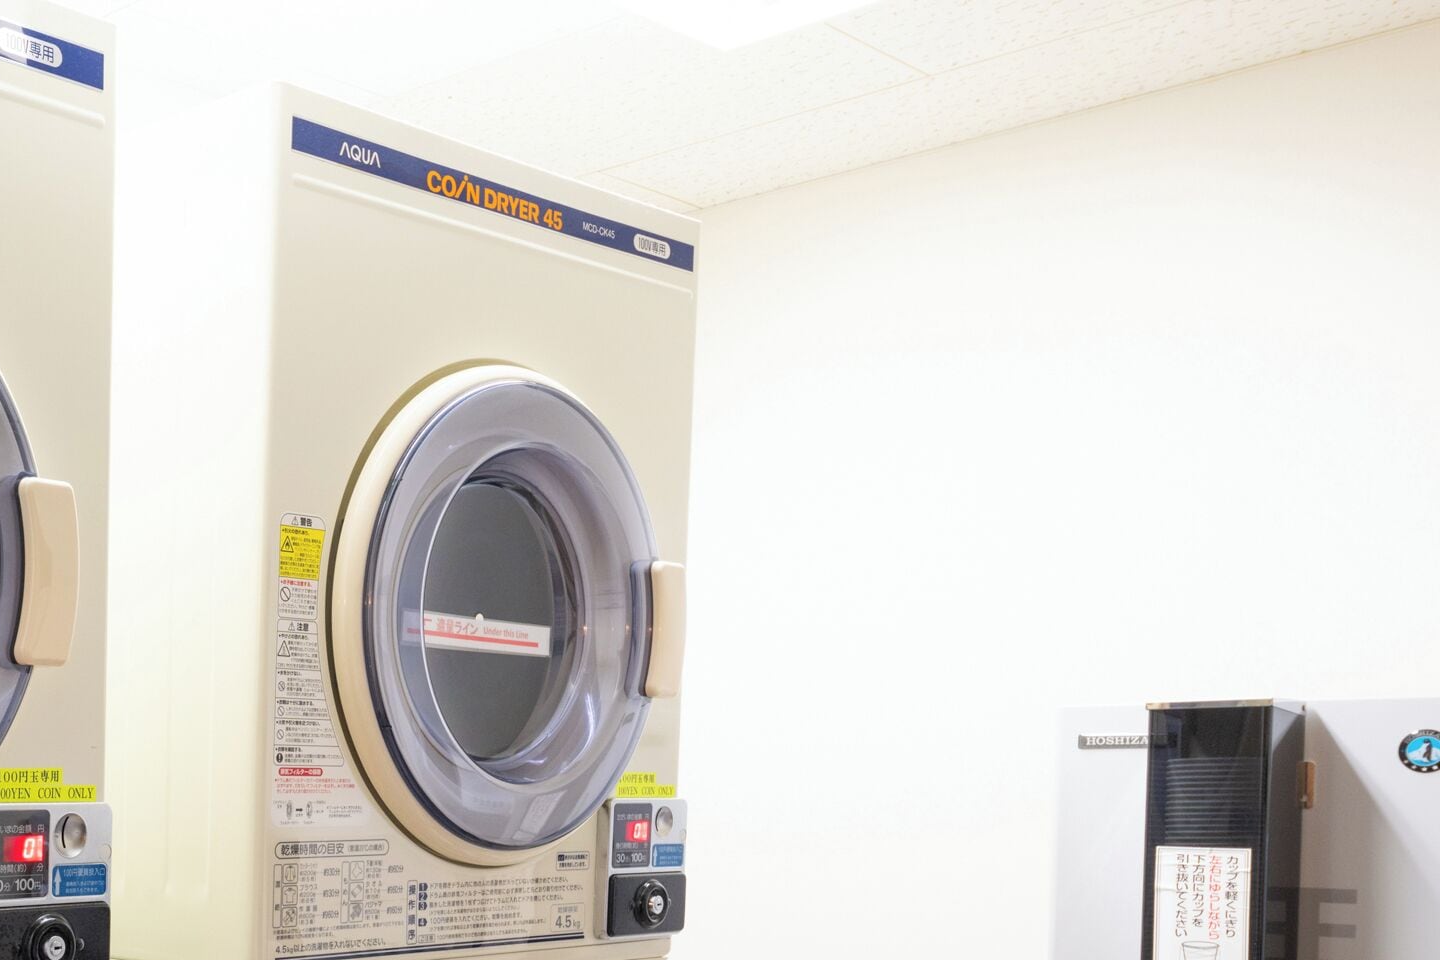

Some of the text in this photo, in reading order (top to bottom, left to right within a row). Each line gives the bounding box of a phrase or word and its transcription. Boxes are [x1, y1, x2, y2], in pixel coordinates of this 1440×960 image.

[340, 142, 381, 169] AQUA
[484, 187, 539, 225] DRYER
[544, 210, 563, 231] 45
[582, 222, 615, 239] MCD-CK45
[38, 787, 61, 799] COIN
[68, 787, 95, 800] ONLY
[281, 843, 344, 855] 乾燥時間の目安
[1175, 854, 1189, 937] 引き抜いてください
[1192, 855, 1205, 927] 下方向にカップを
[1209, 855, 1221, 940] 左右にゆらしながら
[1225, 856, 1239, 938] カップを軽くにぎり
[555, 915, 571, 929] 4.5
[573, 919, 581, 930] kg
